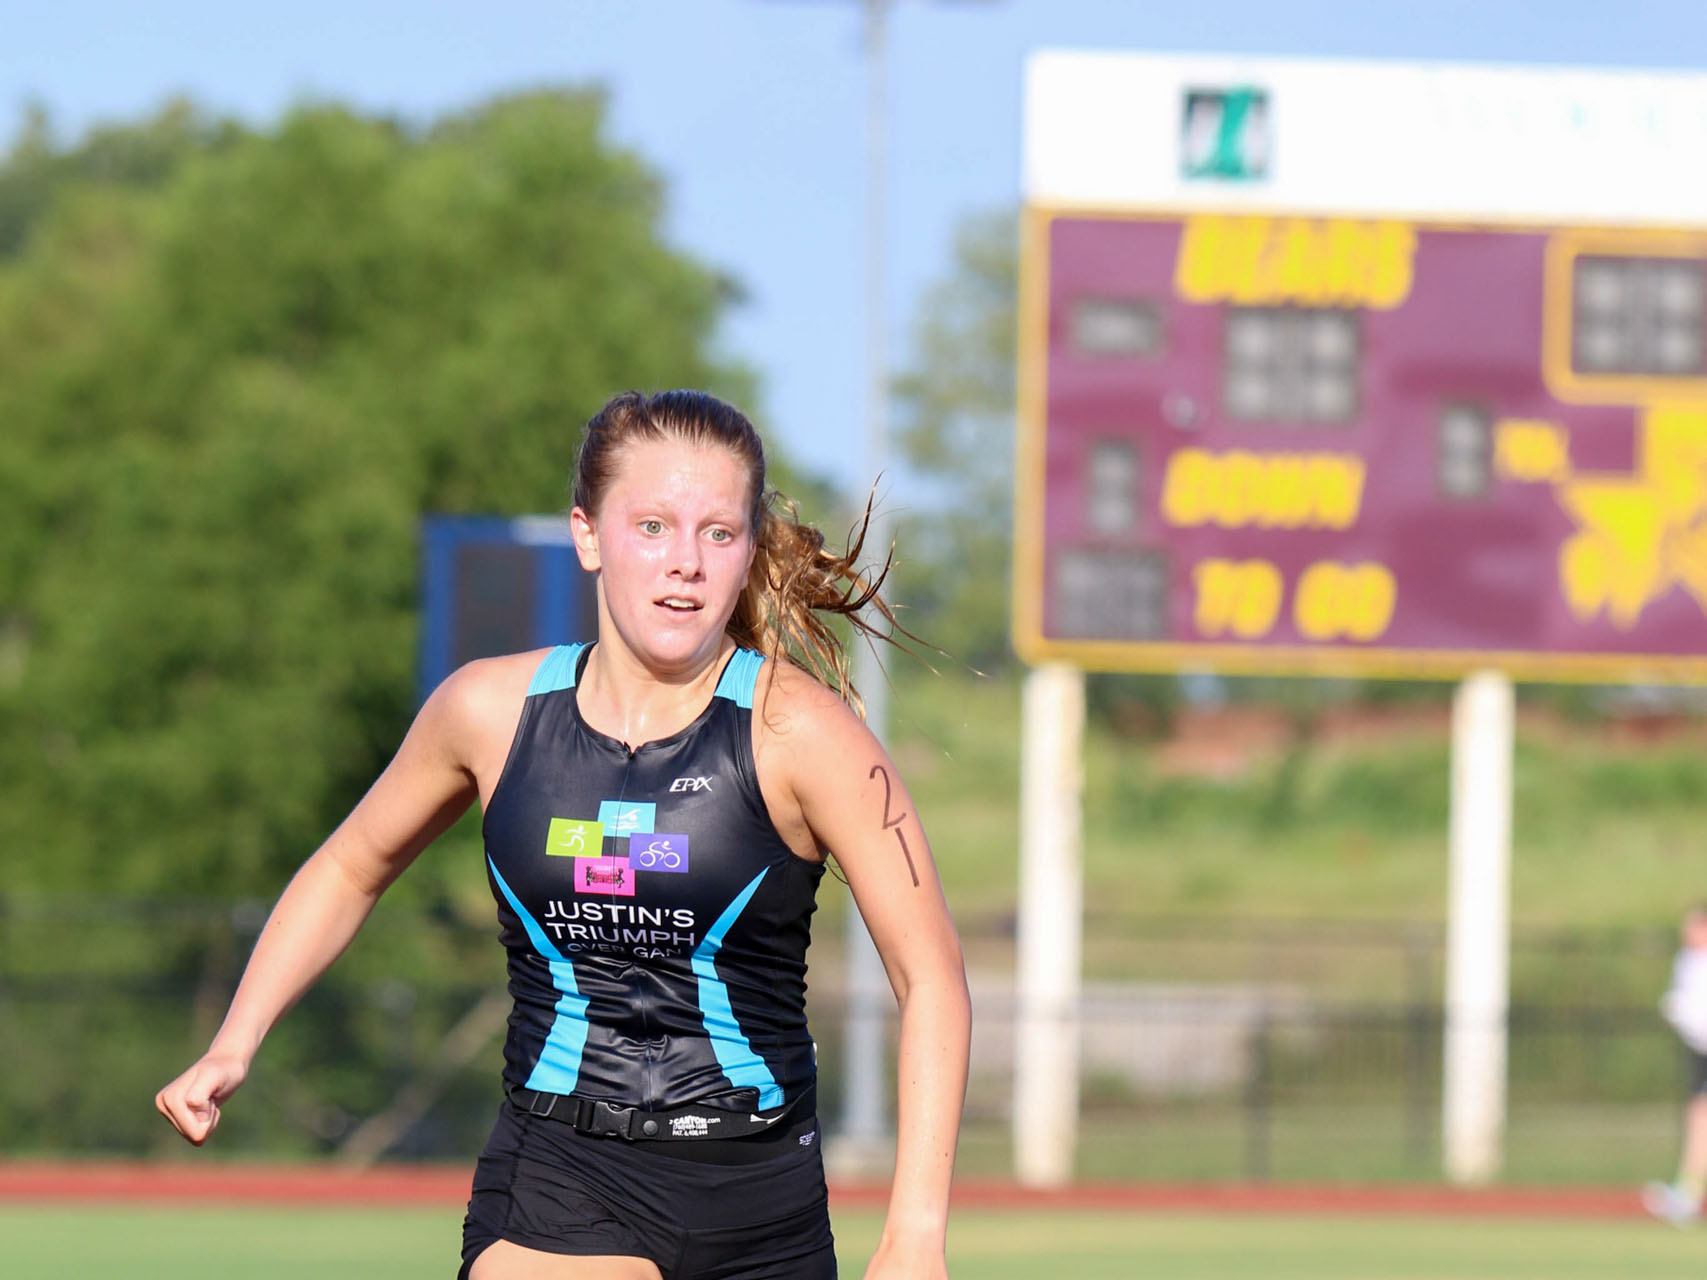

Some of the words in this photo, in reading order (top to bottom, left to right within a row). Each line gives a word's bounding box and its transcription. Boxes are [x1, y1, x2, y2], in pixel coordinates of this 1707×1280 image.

[869, 765, 919, 888] 21
[544, 900, 695, 928] JUSTIN'S
[546, 922, 695, 947] TRIUMPH
